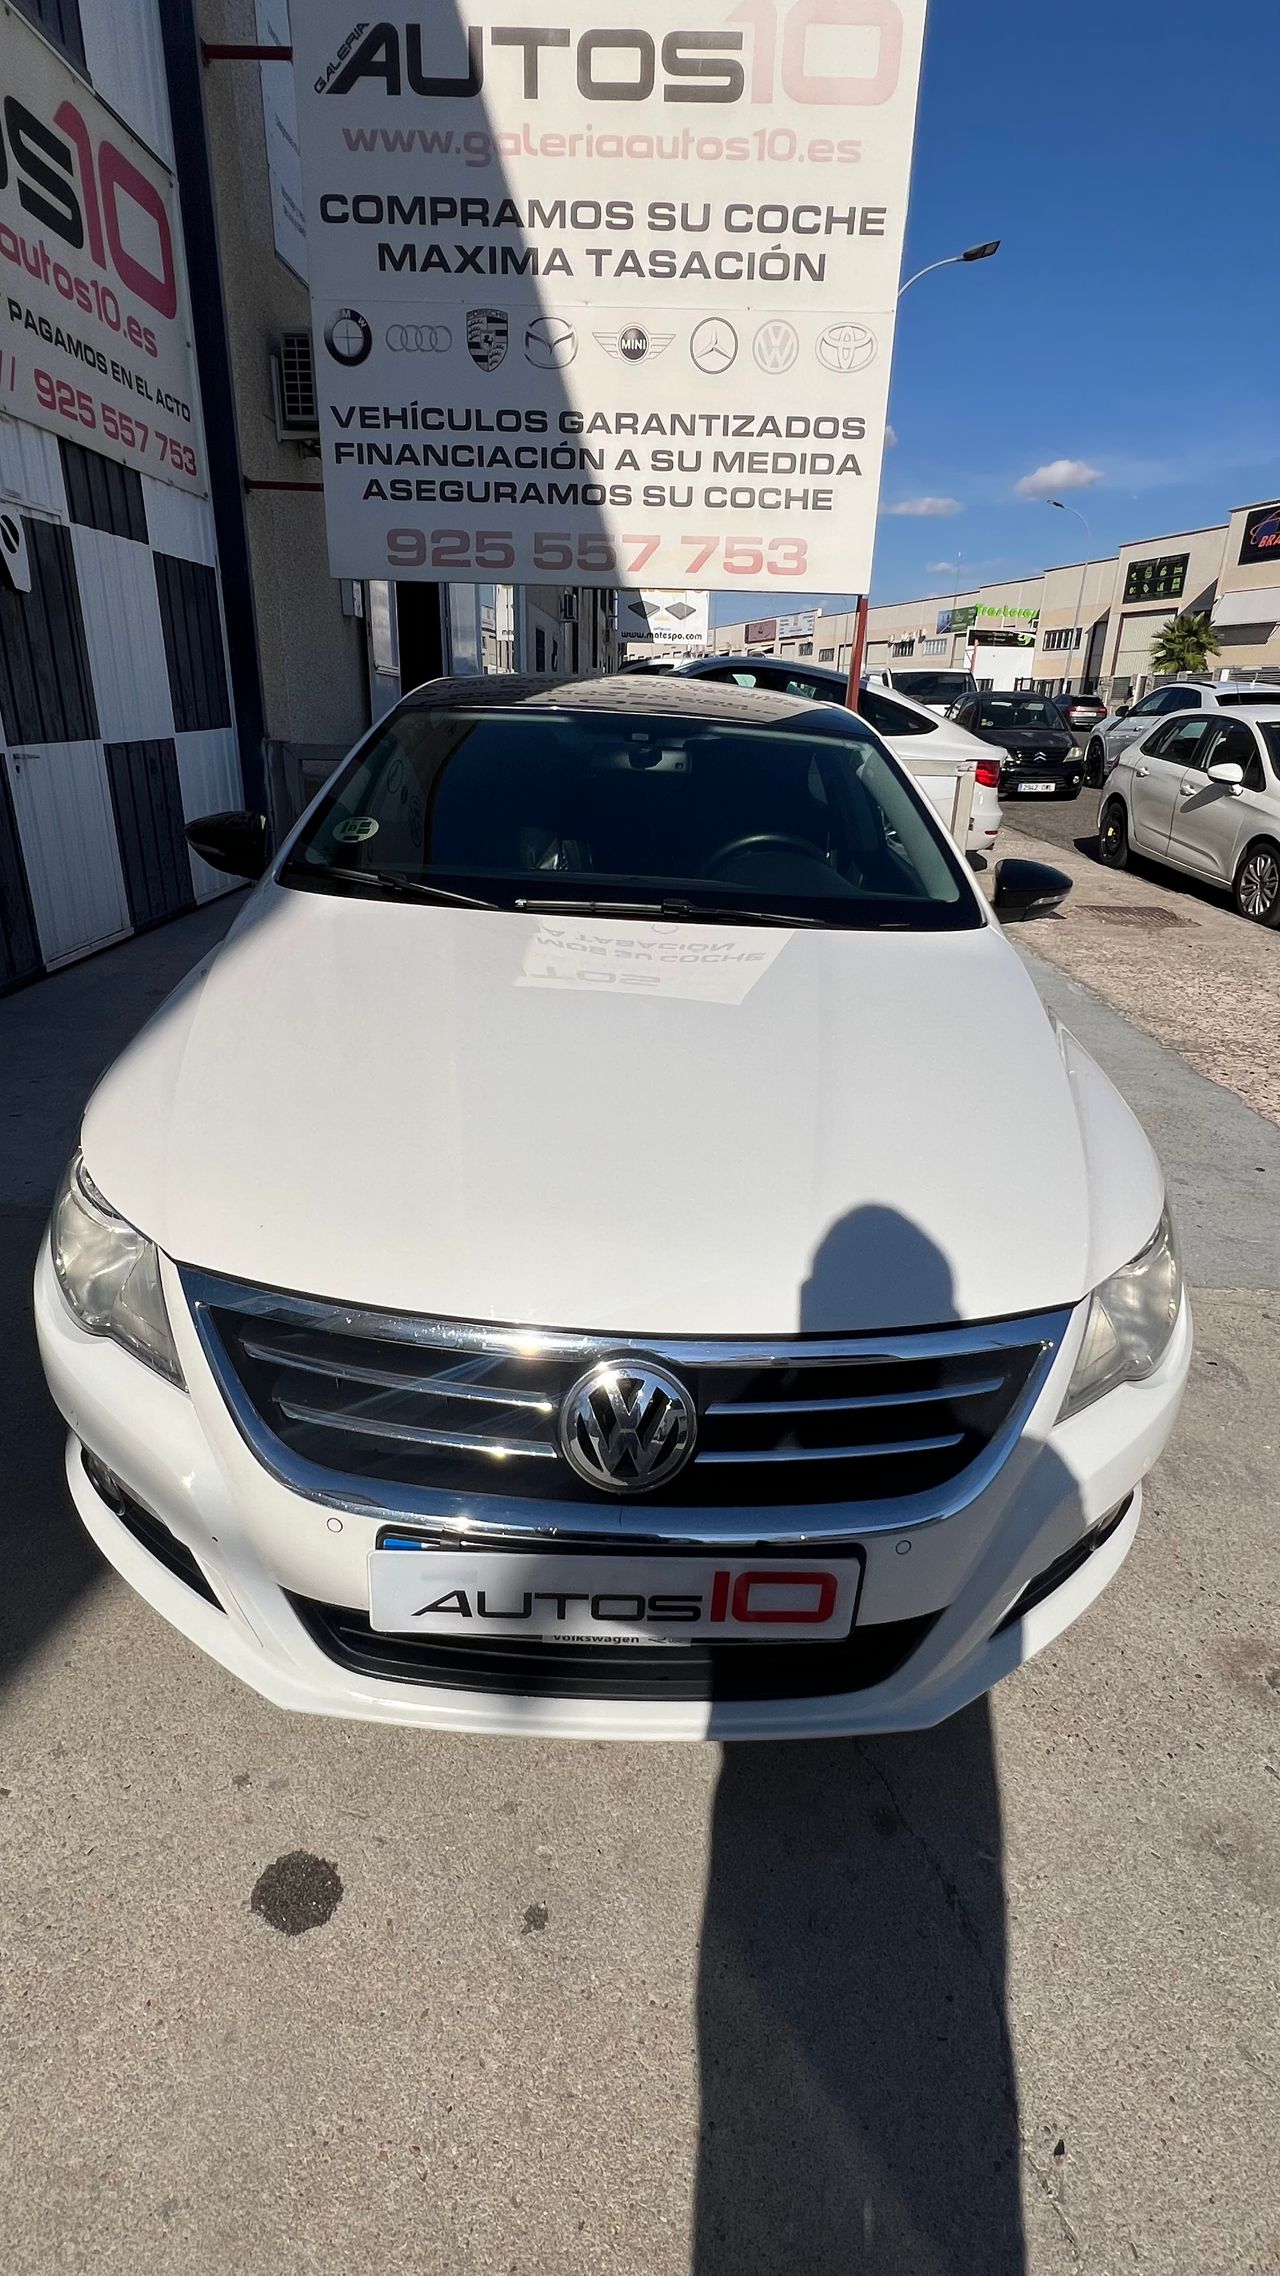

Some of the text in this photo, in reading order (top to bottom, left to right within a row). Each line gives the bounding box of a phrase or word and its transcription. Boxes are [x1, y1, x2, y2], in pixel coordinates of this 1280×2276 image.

[314, 22, 370, 94] GALERIA
[326, 0, 903, 105] AUTOS10
[341, 124, 862, 168] www.galeriaautos10.es
[0, 94, 177, 320] S10
[320, 193, 634, 231] COMPRAMOS
[648, 203, 711, 233] SU
[724, 203, 887, 237] COCHE
[377, 243, 826, 282] MAXIMA TASACIÓN
[7, 296, 191, 423] PAGAMOS EN EL ACTO
[621, 338, 646, 350] MINI
[34, 368, 96, 430] 925
[101, 402, 149, 453] 557
[155, 430, 197, 477] 753
[330, 400, 867, 440] VEHÍCULOS GARANTIZADOS
[334, 441, 863, 477] FINANCIACIÓN A SU MEDIDA
[362, 478, 835, 512] ASEGURAMOS SU COCHE
[387, 528, 809, 577] 925 557 753
[621, 631, 703, 641] www.matespo.com
[411, 1571, 838, 1624] AUTOS10
